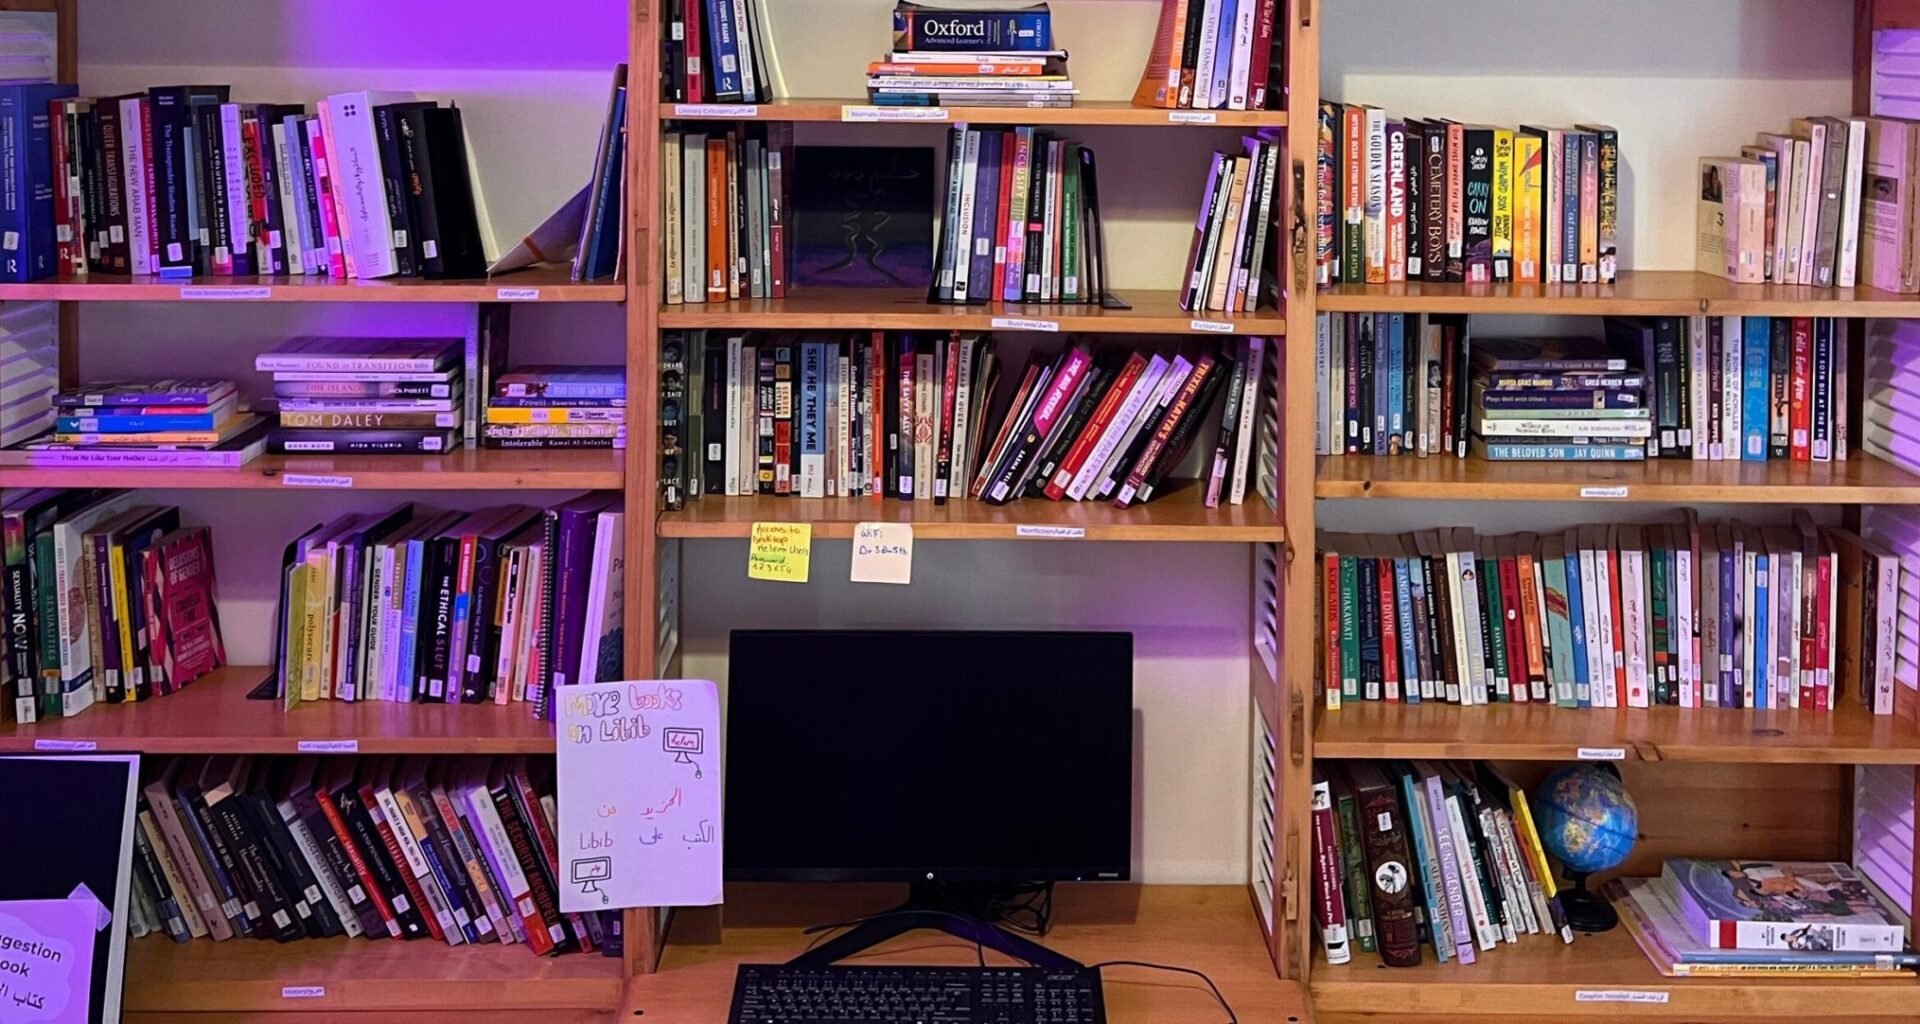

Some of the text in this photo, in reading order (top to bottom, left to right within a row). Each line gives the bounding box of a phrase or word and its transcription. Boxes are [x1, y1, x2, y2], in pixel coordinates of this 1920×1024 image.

[924, 20, 984, 36] Oxford
[103, 124, 120, 217] QUEER TRANSFIGURATIONS
[130, 165, 138, 186] NEW
[164, 140, 174, 184] Transgender
[244, 137, 265, 200] EXCLUDED
[1014, 141, 1028, 200] INCLUSIFY
[1256, 163, 1264, 184] Perfumed
[1369, 120, 1380, 208] THE GOLDEN SEASON
[1389, 130, 1404, 217] GREENLAND
[1254, 185, 1262, 202] Garden
[1261, 148, 1277, 212] NO FUTURE
[1466, 181, 1490, 198] CARRY
[1496, 160, 1508, 211] WAYWARD SON
[132, 189, 140, 214] ARAB
[962, 194, 970, 235] INCLUSION
[1427, 153, 1442, 263] CEMETERY BOYS
[1468, 198, 1487, 214] ON
[1493, 215, 1501, 238] ROWELL
[1350, 224, 1358, 278] NISHANT BATSHA
[1792, 330, 1806, 401] Felix Ever After
[330, 382, 362, 392] ISLAND
[805, 348, 817, 450] SHE/HE/THEY/ME
[840, 386, 847, 399] WE
[901, 369, 910, 435] THE SAVVY ALLY
[1156, 360, 1209, 442] TRIXIE KATYA'S
[286, 413, 384, 427] TOM DALEY
[1088, 393, 1141, 473] AFTER THE PARTY
[61, 454, 146, 462] Treat Me Like Your Mother
[1495, 448, 1564, 457] THE BELOVED SON
[1574, 448, 1616, 458] JAY QUINN
[756, 524, 800, 534] Access to
[12, 570, 22, 610] SEXUALITY
[1364, 567, 1372, 585] WRONG
[1424, 569, 1432, 584] BRIDE
[1425, 584, 1432, 593] OF
[1327, 567, 1337, 622] KOOLAIDS
[1365, 595, 1372, 603] OF
[1425, 593, 1434, 615] AMMAN
[46, 595, 56, 661] SEXUALITIES
[434, 576, 450, 670] THE ETHICAL SLUT
[1342, 591, 1352, 640] HAKAWATI
[1382, 603, 1393, 637] DIVINE
[1397, 574, 1413, 651] ANGEL HISTORY
[306, 614, 316, 662] polysecure
[629, 685, 682, 710] books
[568, 715, 650, 744] on Libib
[598, 787, 682, 820] المزيد من
[360, 830, 373, 847] AND
[435, 796, 461, 833] QUEER
[451, 827, 476, 863] BROWN
[580, 831, 614, 850] Libib
[639, 820, 714, 850] الكتب على
[1498, 821, 1509, 837] Our
[296, 822, 346, 905] TRANSGENDER HISTORY
[342, 839, 368, 877] sexuality
[366, 843, 392, 883] PUNISHMENT
[1503, 835, 1515, 861] Dreams
[236, 847, 267, 894] Homosexuality
[246, 843, 283, 904] The Construction of
[1326, 845, 1337, 890] ALISON BECHDEL
[1434, 826, 1467, 918] SEEING GENDER
[1472, 857, 1485, 880] Home
[1512, 869, 1523, 886] Dusk
[1427, 856, 1452, 932] CALL ME NATHAN
[0, 934, 62, 963] gestion
[0, 961, 30, 978] ook
[13, 992, 45, 1010] كتاب
